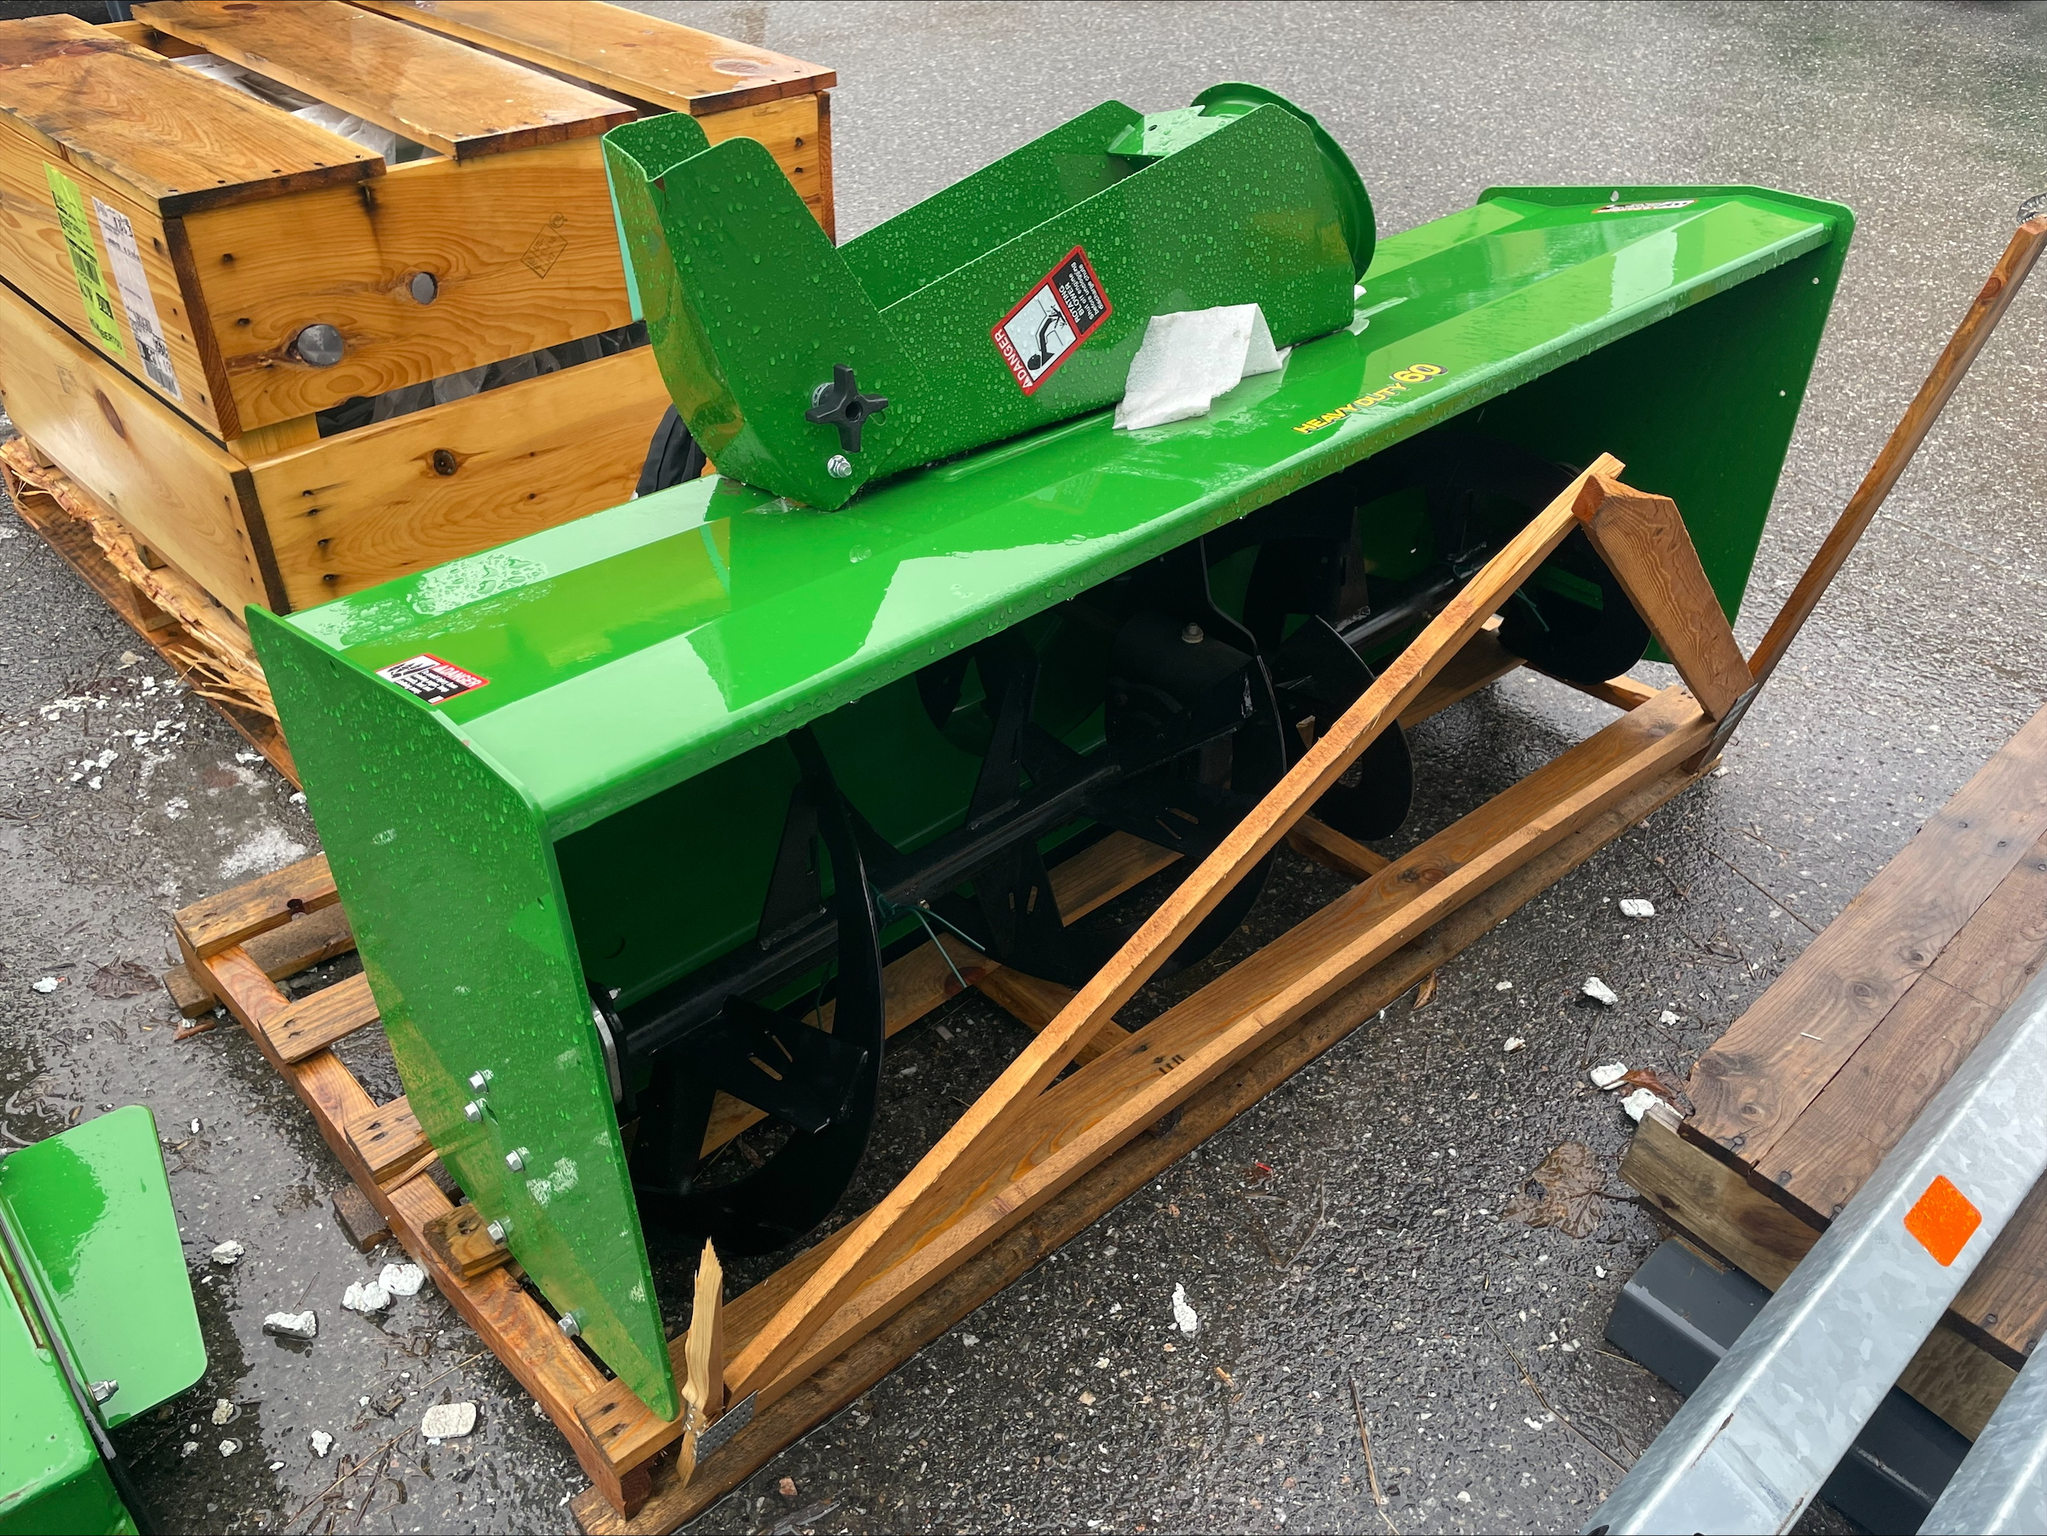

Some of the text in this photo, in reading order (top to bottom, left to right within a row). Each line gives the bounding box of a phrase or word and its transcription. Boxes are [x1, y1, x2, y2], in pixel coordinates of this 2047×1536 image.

[1069, 273, 1082, 294] engine
[1071, 262, 1090, 296] unclogging
[1059, 285, 1081, 323] ROTATING
[1065, 282, 1085, 316] BLOWER
[1084, 304, 1095, 320] Shut
[1088, 295, 1099, 315] before
[995, 329, 1027, 381] DANGER
[1293, 363, 1448, 434] HEAVY DUTY 60
[443, 667, 482, 688] DANGER
